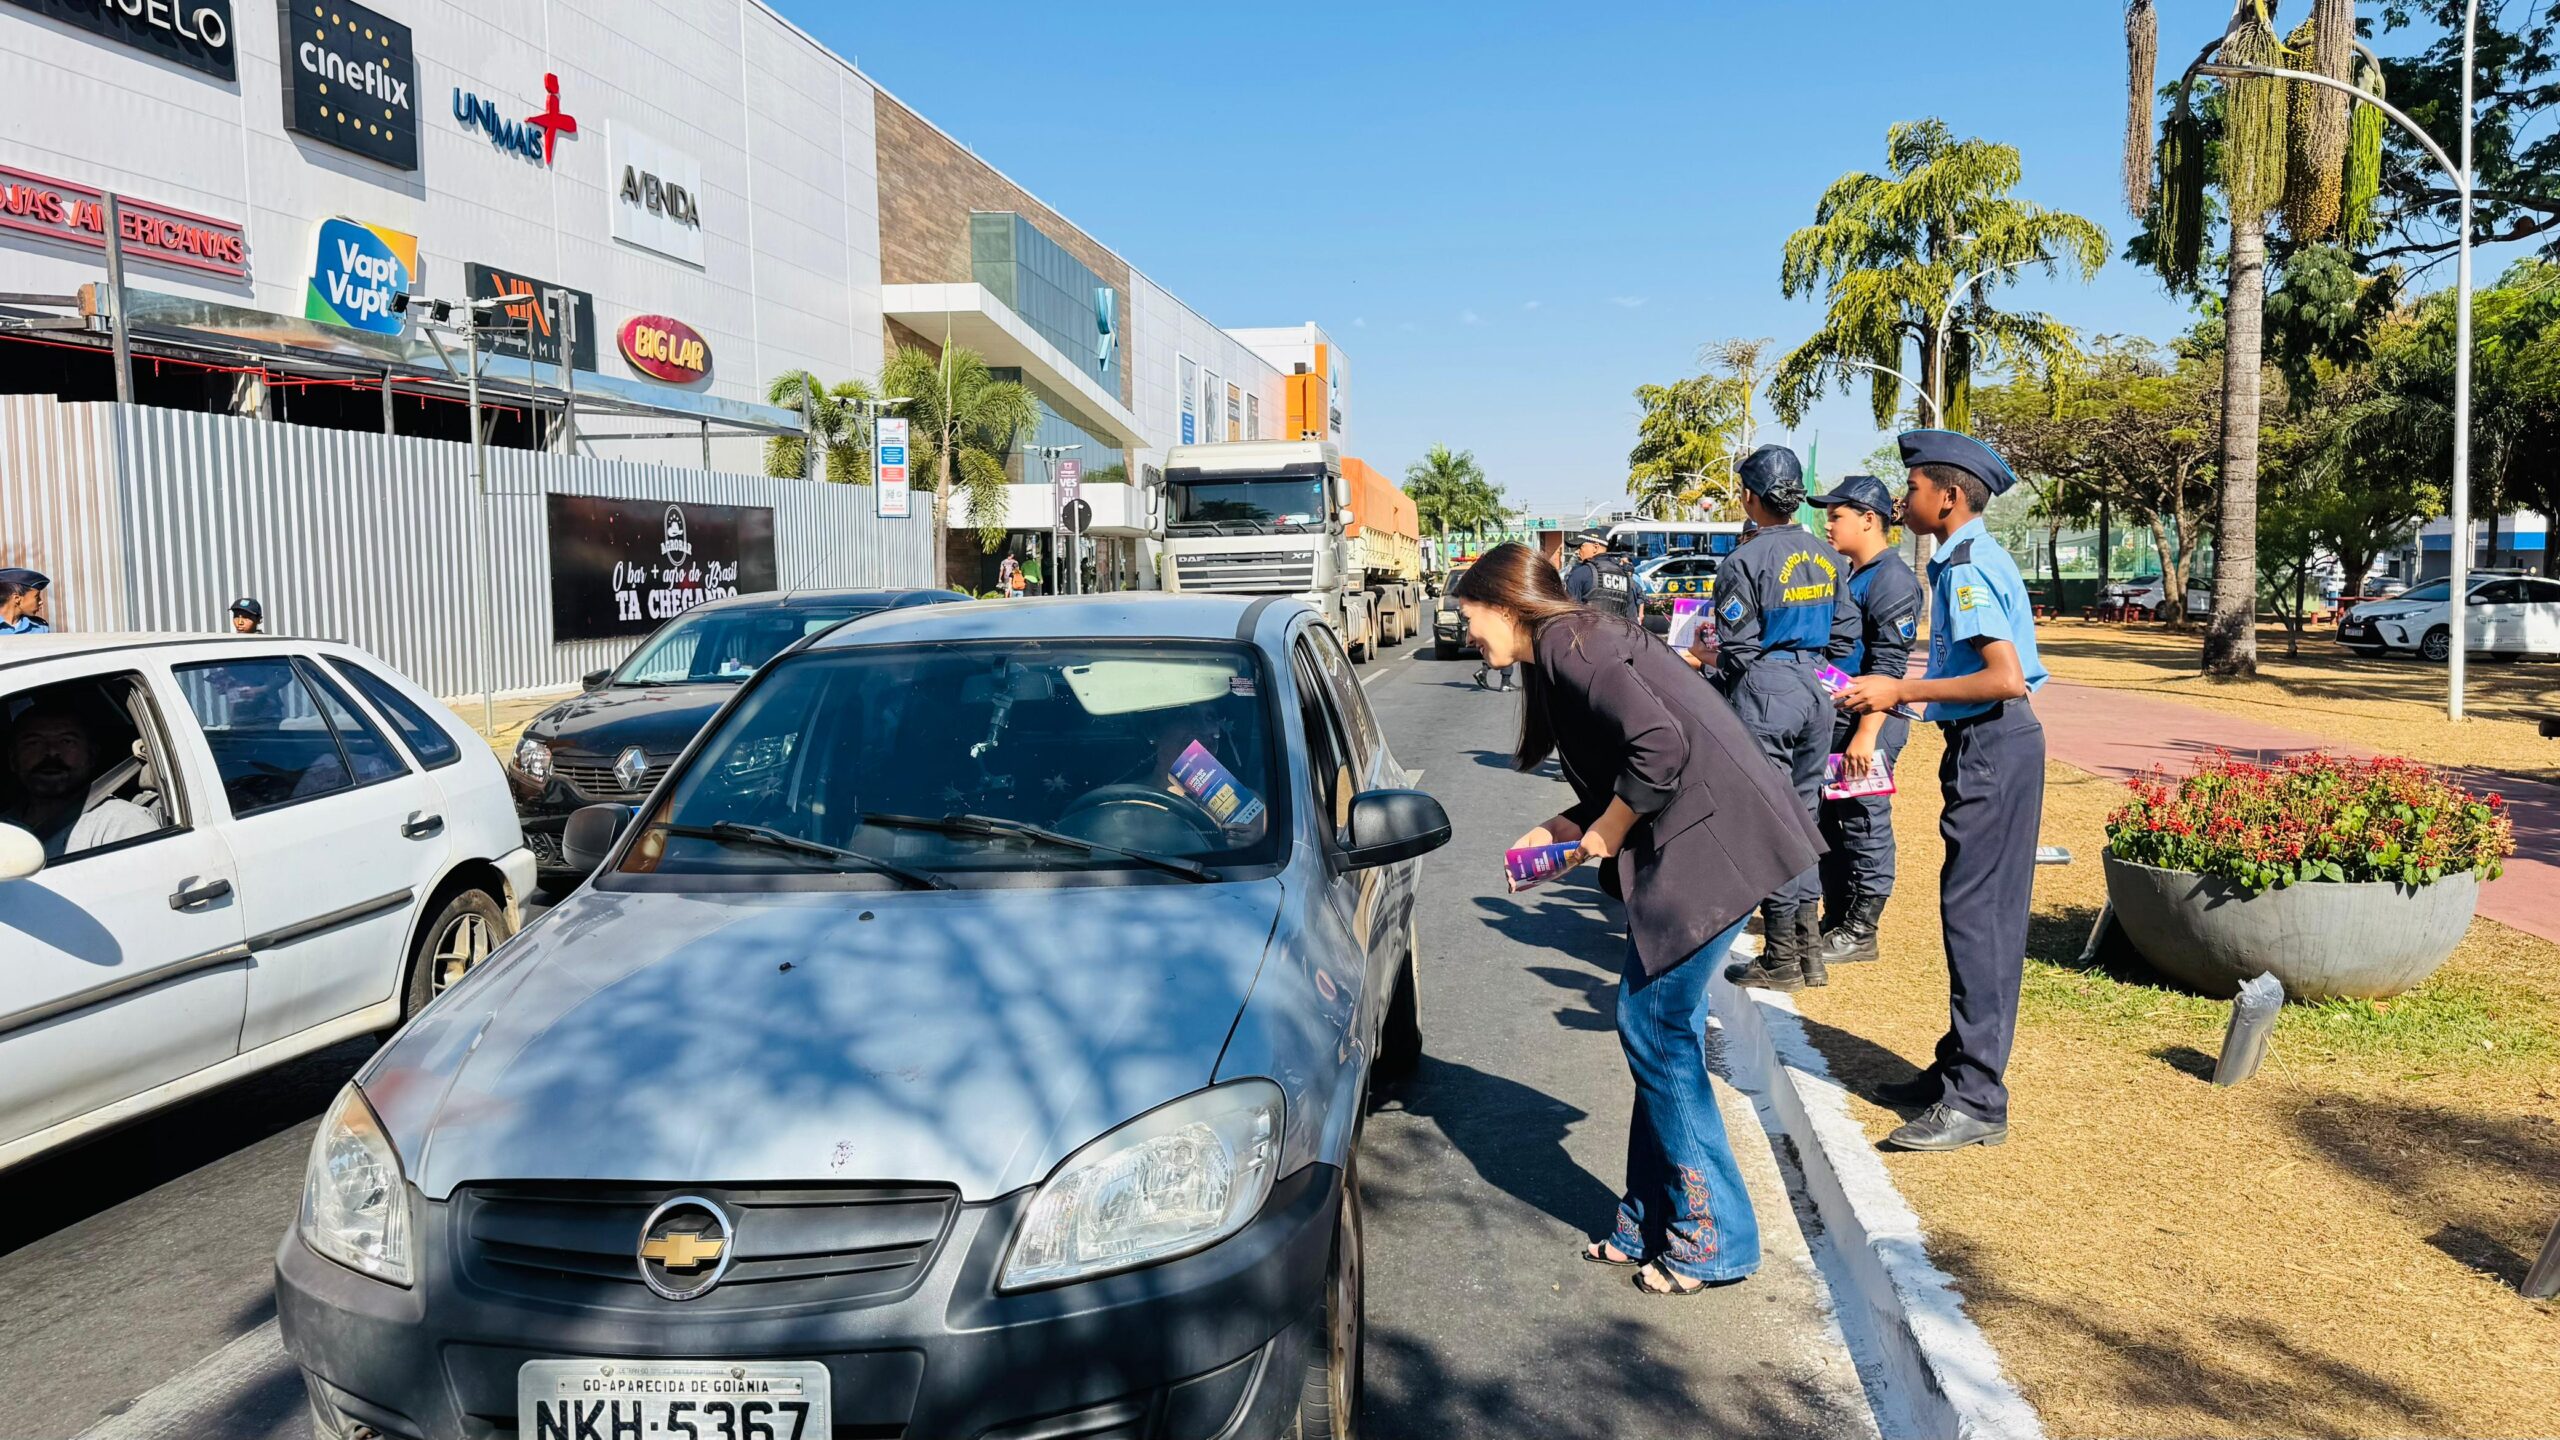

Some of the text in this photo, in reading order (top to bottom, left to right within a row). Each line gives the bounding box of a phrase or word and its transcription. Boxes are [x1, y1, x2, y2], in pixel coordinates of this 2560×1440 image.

[300, 41, 409, 110] cineflix
[453, 87, 543, 160] UNIMAIS
[620, 164, 701, 232] AVENIDA
[337, 238, 398, 290] Vapt
[327, 269, 390, 321] Vupt
[635, 325, 704, 372] BIG LAR
[1060, 478, 1077, 487] VES
[1064, 488, 1073, 497] TI
[660, 539, 692, 555] AGROBAR
[612, 561, 624, 592] O
[627, 561, 647, 583] bar
[662, 566, 686, 590] agro
[688, 561, 702, 582] do
[705, 560, 738, 589] Brasil
[1603, 573, 1627, 592] GCM
[1779, 550, 1837, 584] GUARDA MIRIM
[615, 583, 642, 621] TÁ
[583, 1379, 770, 1393] GO-APARECIDA DE GOIANIA
